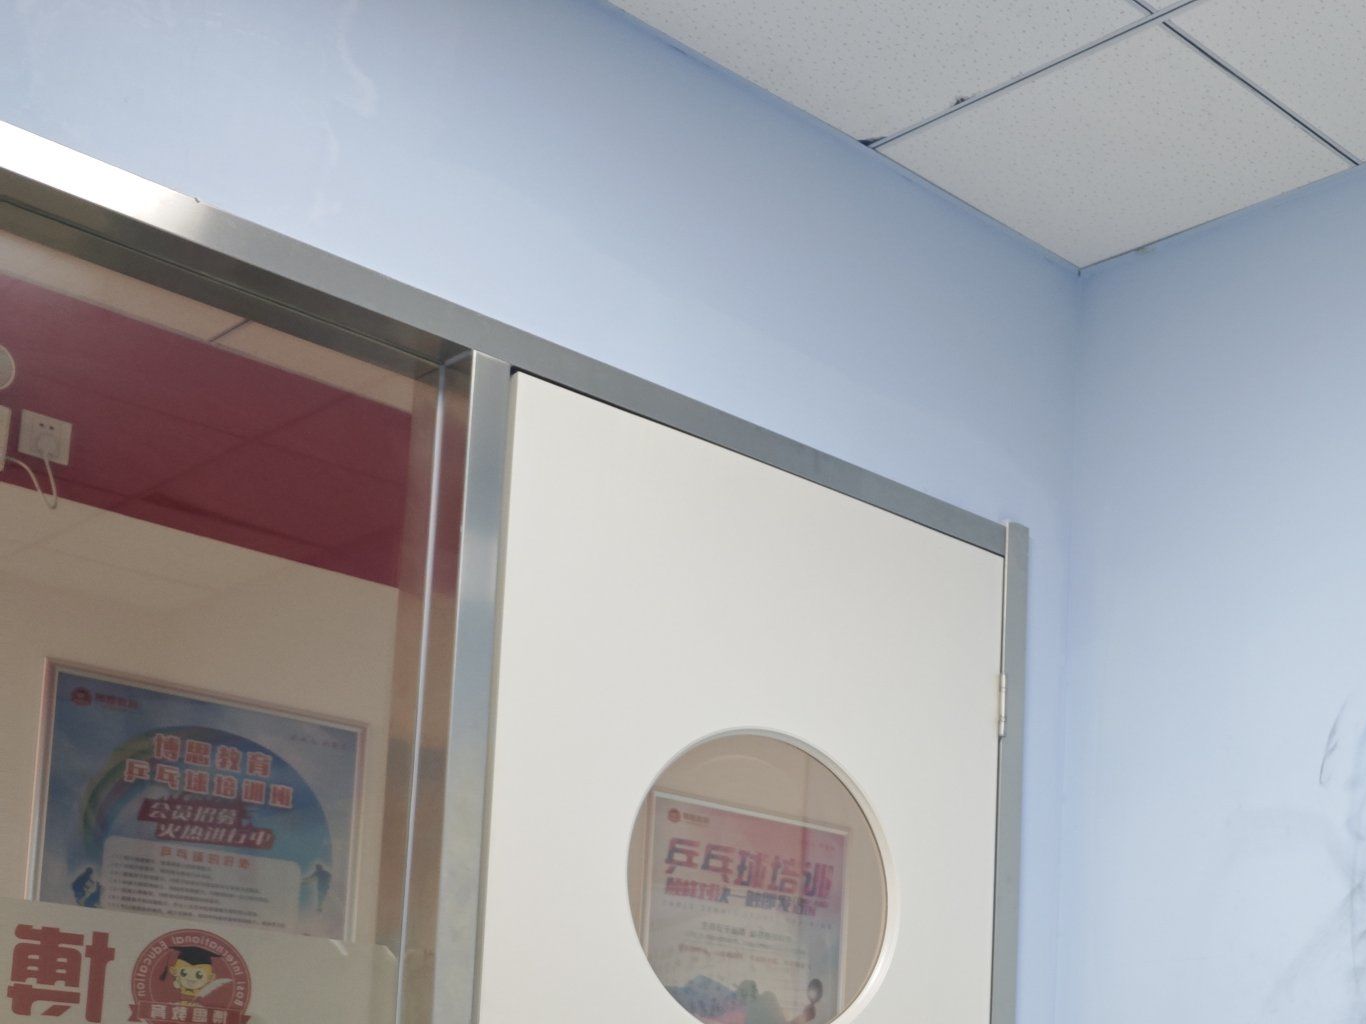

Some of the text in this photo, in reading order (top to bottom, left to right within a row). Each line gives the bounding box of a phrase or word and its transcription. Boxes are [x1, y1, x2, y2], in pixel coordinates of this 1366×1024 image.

[153, 733, 272, 778] 博思教育
[124, 758, 293, 810] 乒乓球培训班
